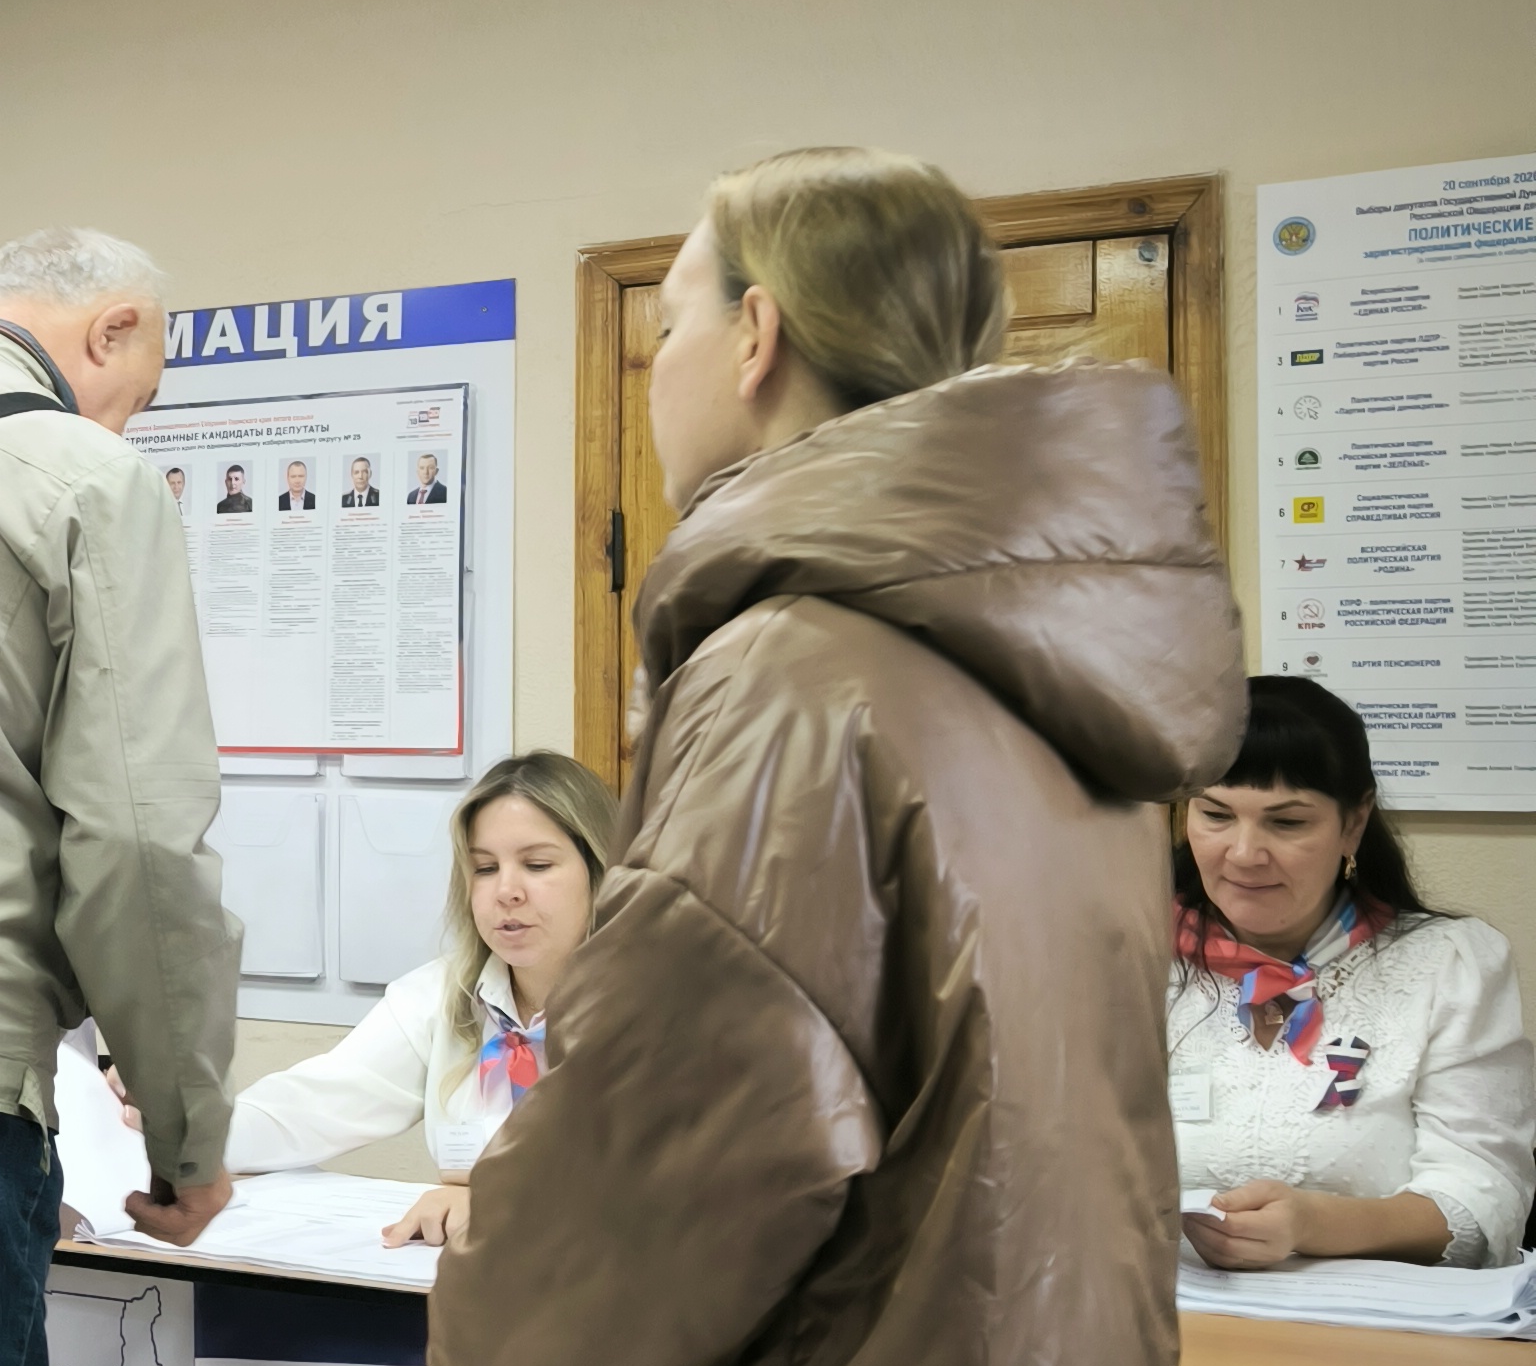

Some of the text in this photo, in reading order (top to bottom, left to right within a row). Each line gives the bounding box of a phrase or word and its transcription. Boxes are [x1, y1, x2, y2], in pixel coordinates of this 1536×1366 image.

[1408, 217, 1534, 241] ПОЛИТИЧЕСКИЕ
[165, 292, 402, 359] МАЦИЯ
[1277, 357, 1283, 366] 3
[1277, 407, 1283, 416] 4
[202, 428, 264, 441] КАНДИДАТЫ
[266, 427, 272, 436] В
[274, 424, 330, 436] ДЕПУТАТЫ
[1278, 458, 1283, 467] 5
[1279, 508, 1285, 517] 6
[1280, 559, 1285, 569] 7
[1281, 611, 1287, 620] 8
[1282, 662, 1288, 672] 9
[1361, 712, 1423, 720] УНИСТИЧЕСКАЯ
